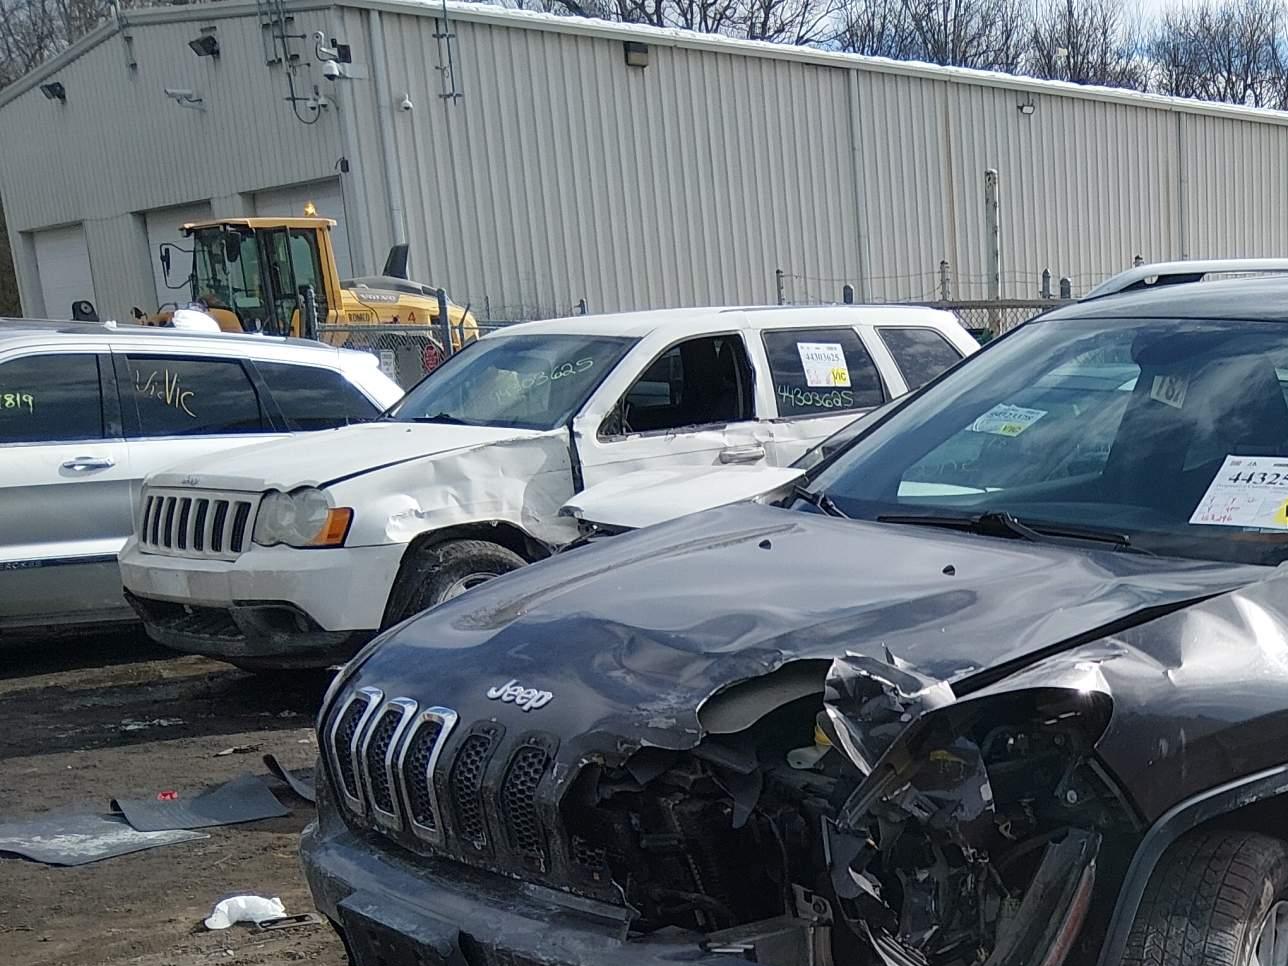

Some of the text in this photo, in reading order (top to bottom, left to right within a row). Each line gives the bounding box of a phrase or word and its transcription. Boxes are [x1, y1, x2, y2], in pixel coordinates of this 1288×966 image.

[407, 311, 416, 323] 4
[832, 370, 847, 380] VIC
[777, 390, 854, 408] 44303625
[487, 679, 553, 711] Jeep
